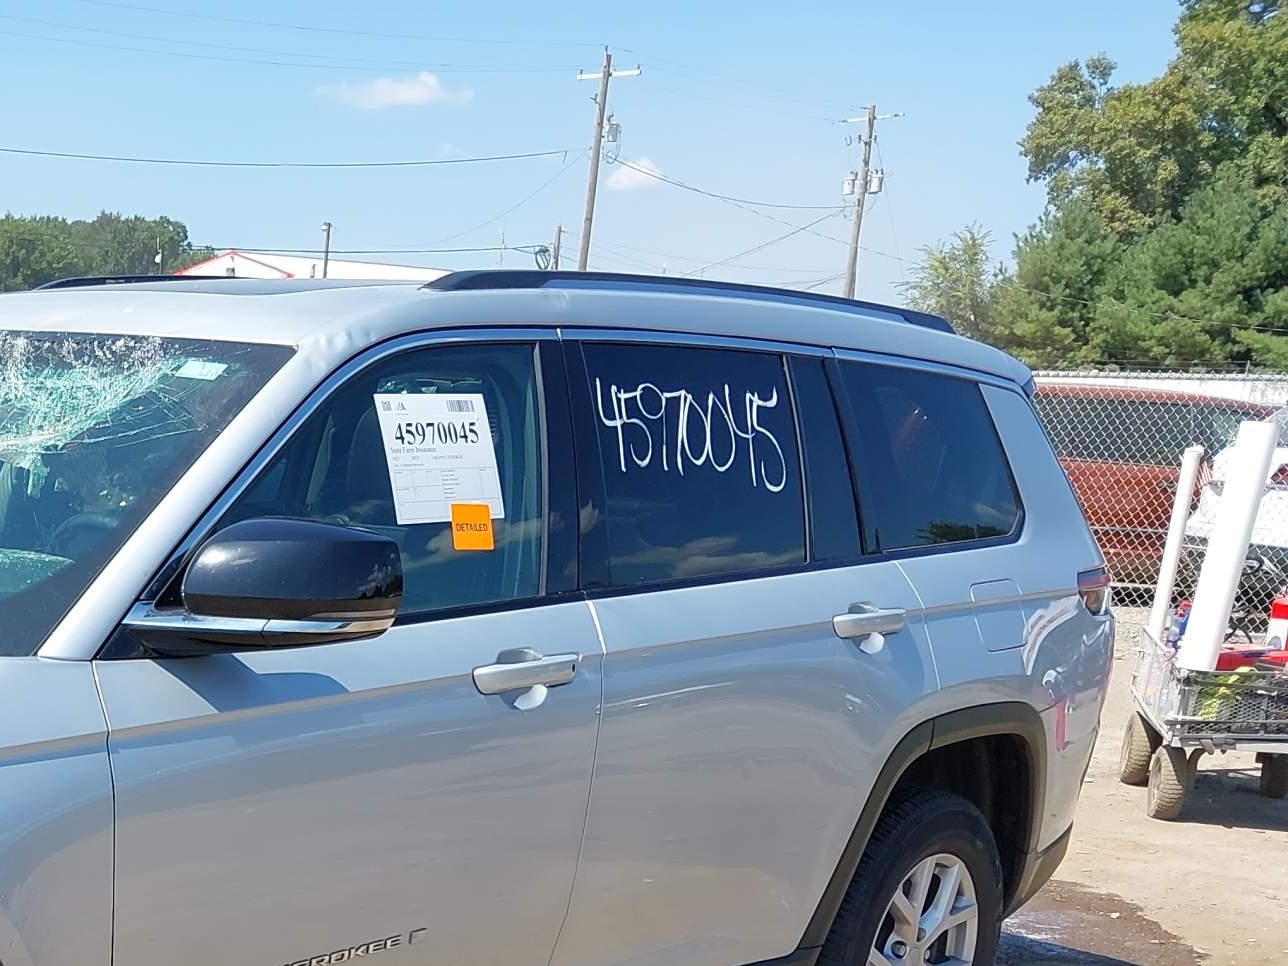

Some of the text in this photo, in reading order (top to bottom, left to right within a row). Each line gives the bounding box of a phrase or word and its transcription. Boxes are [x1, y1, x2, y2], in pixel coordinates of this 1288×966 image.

[395, 422, 479, 445] 45970045
[595, 377, 787, 493] 45970045
[456, 523, 488, 532] DETAILED
